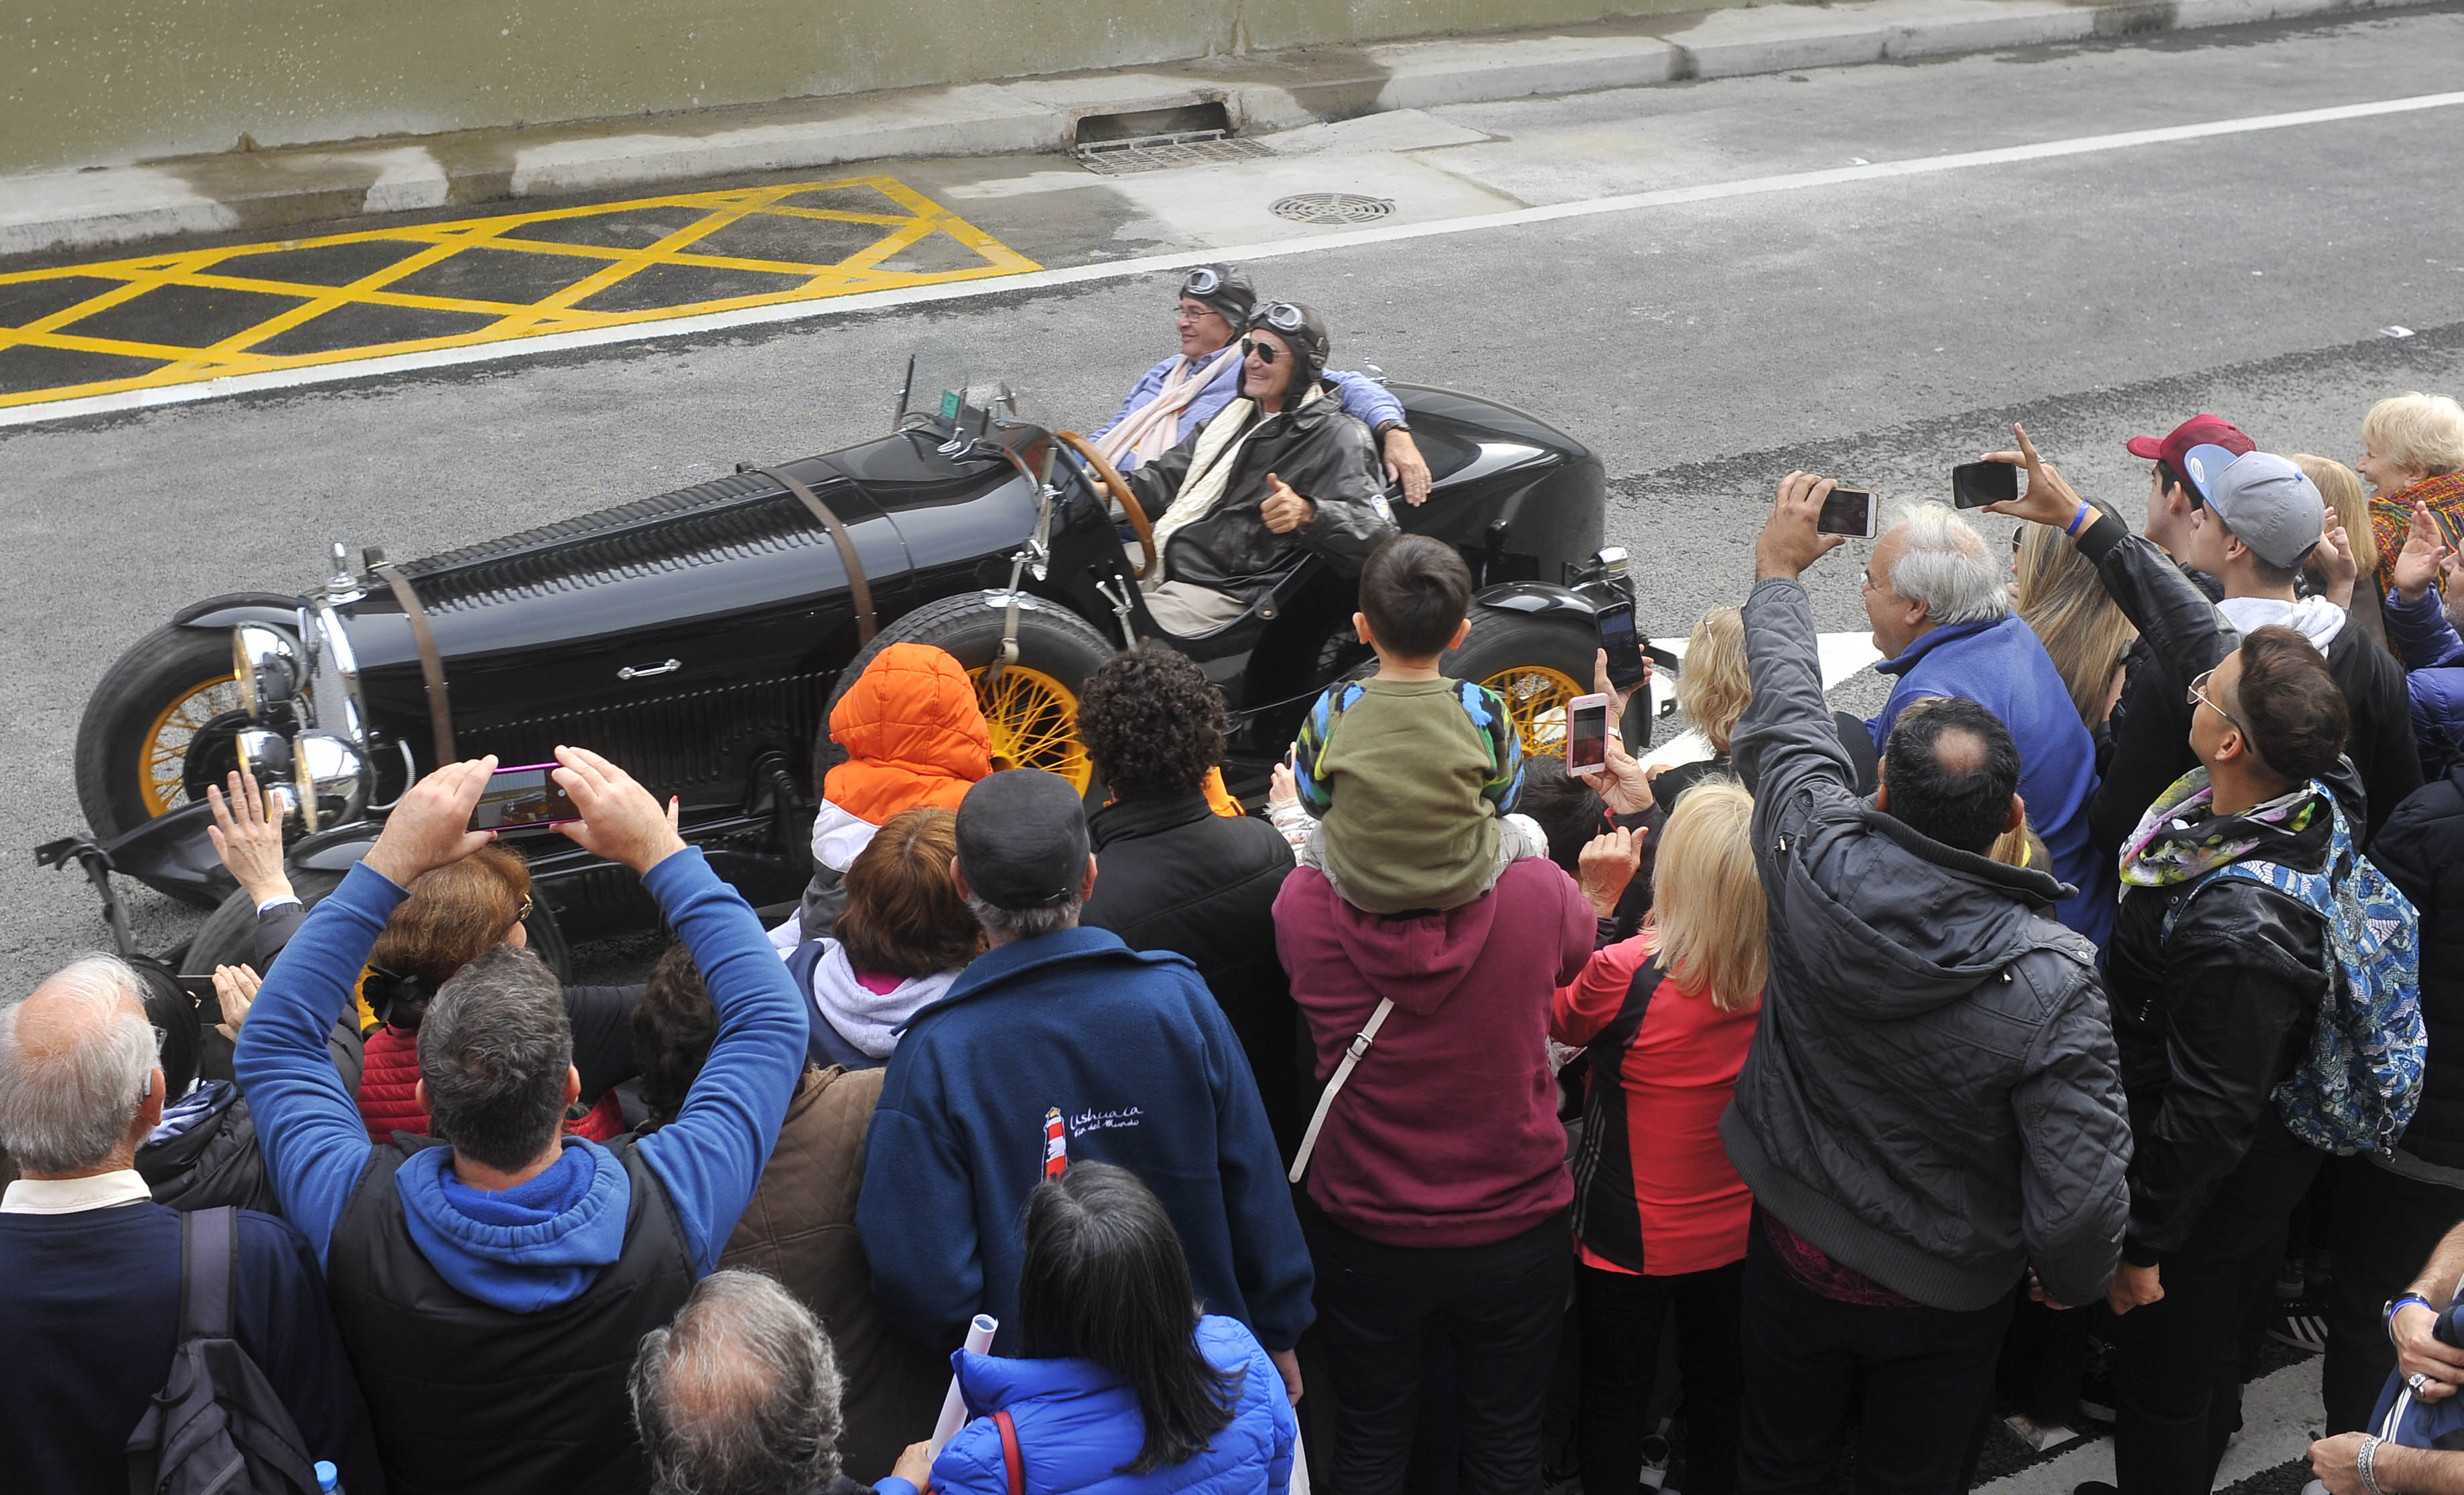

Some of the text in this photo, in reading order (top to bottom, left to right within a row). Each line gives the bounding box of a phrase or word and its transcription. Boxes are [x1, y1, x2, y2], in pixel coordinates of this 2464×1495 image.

[1070, 1107, 1144, 1130] Ushuaia
[1087, 1119, 1101, 1131] del
[1103, 1119, 1139, 1128] Mundo
